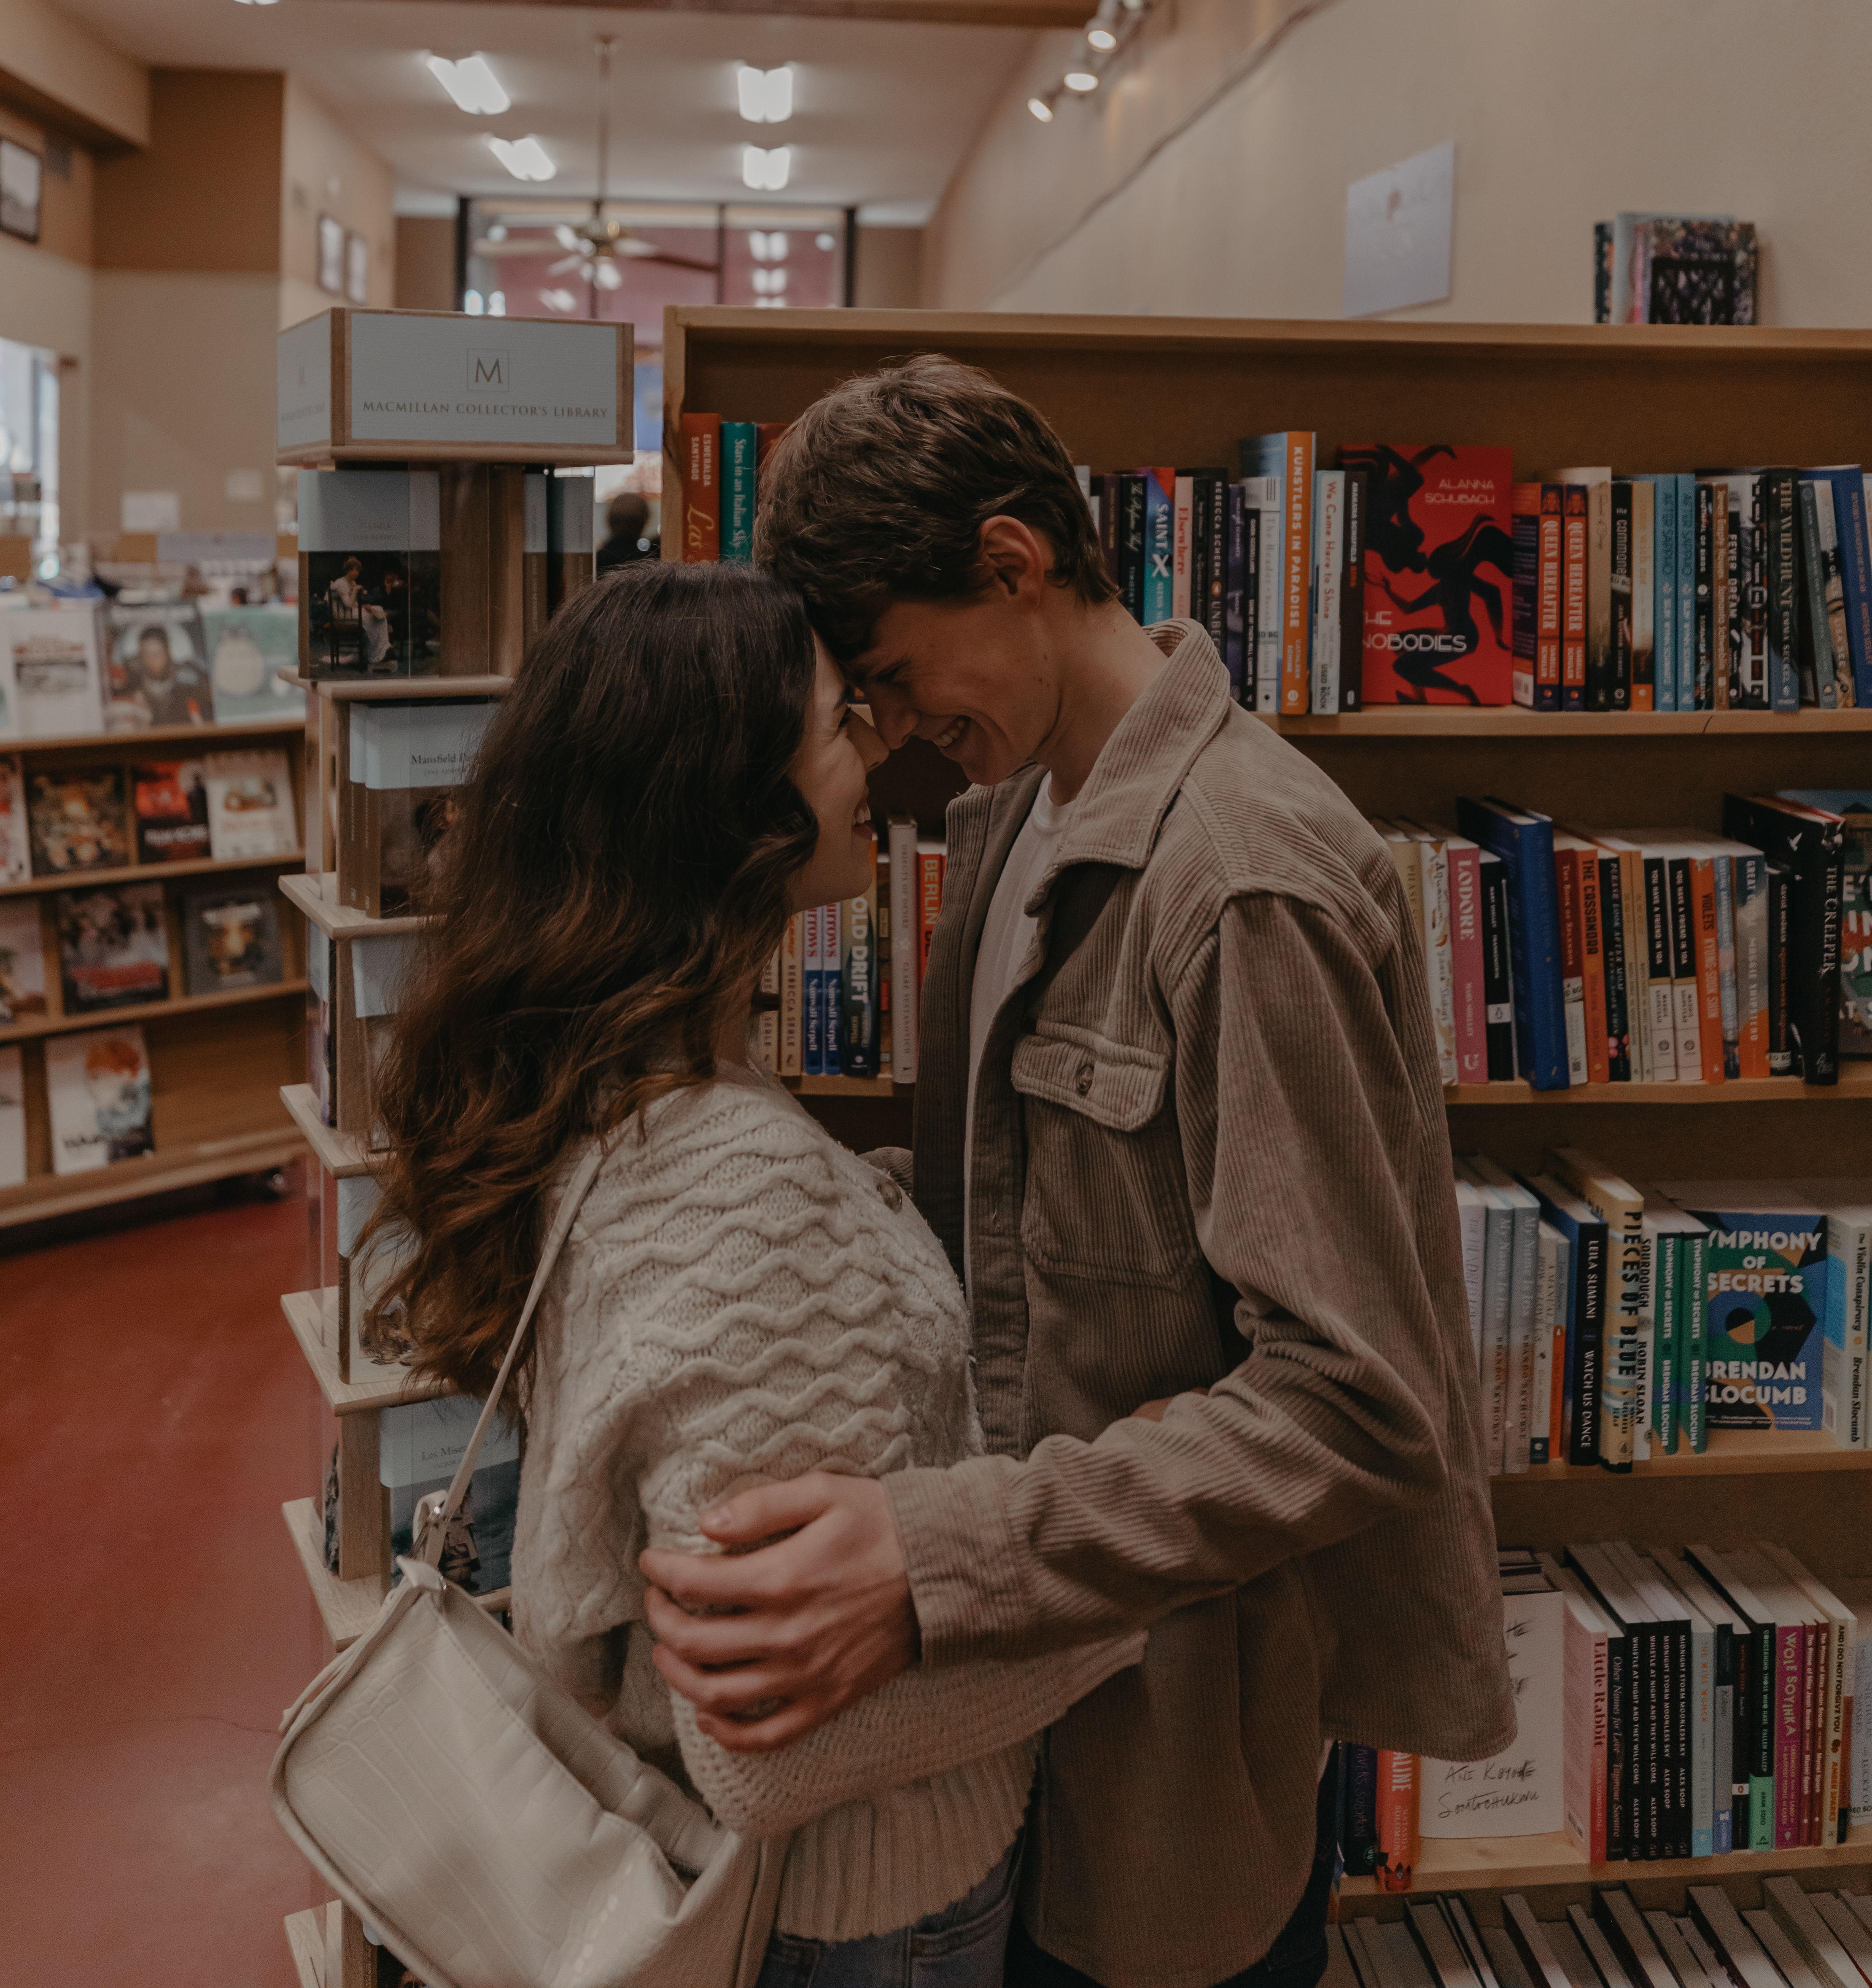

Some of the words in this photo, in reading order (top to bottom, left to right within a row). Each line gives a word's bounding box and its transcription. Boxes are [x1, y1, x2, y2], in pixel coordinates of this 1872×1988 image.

[475, 357, 502, 384] M
[363, 401, 450, 413] MACMILLAN
[456, 403, 547, 416] COLLECTOR'S
[553, 406, 607, 418] LIBRARY
[691, 436, 700, 480] SANTIAGO
[703, 433, 712, 487] ESMERALDA
[734, 438, 746, 464] Stars
[734, 465, 743, 476] in
[734, 478, 743, 492] an
[1438, 479, 1495, 490] ALANNA
[1292, 446, 1304, 530] KUNSTLERS
[1326, 481, 1337, 500] We
[1425, 492, 1495, 504] SCHUBACH
[1780, 482, 1793, 512] THE
[733, 494, 747, 527] Italian
[1214, 481, 1222, 530] REBECCA
[1325, 504, 1336, 535] Came
[687, 503, 714, 548] Las
[728, 529, 747, 548] Sky
[1156, 503, 1169, 549] SAINT
[1177, 508, 1189, 575] Elsewhere
[1543, 520, 1558, 558] QUEEN
[1568, 522, 1584, 559] QUEEN
[1780, 513, 1793, 562] WILD
[1214, 533, 1222, 576] SCHERM
[1292, 535, 1302, 550] IN
[1324, 541, 1335, 568] Here
[1729, 534, 1737, 570] FEVER
[1152, 553, 1170, 577] X
[1324, 573, 1334, 584] to
[1290, 556, 1301, 628] PARADISE
[1543, 561, 1558, 629] HEREAFTER
[1568, 563, 1583, 631] HEREAFTER
[1729, 578, 1738, 619] DREAM
[1780, 562, 1793, 608] HUNT
[1323, 588, 1334, 619] Shine
[1247, 677, 1252, 686] ME
[411, 754, 456, 764] Mansfield
[1583, 859, 1594, 881] THE
[1651, 869, 1659, 885] YOU
[1746, 860, 1755, 890] GREAT
[1826, 865, 1837, 893] THE
[924, 859, 938, 926] BERLIN
[1457, 859, 1475, 940] LODORE
[1652, 886, 1660, 905] HAVE
[851, 896, 868, 942] OLD
[1584, 886, 1598, 955] CASSANDRA
[1654, 914, 1662, 939] FRIEND
[1702, 893, 1715, 931] VIOLETS
[1656, 940, 1662, 948] IN
[1819, 898, 1839, 979] CREEPER
[850, 943, 868, 1003] DRIFT
[1704, 937, 1718, 994] KYUNG-SOOK
[787, 965, 796, 1012] REBECCA
[1707, 996, 1719, 1019] SHIN
[764, 1017, 772, 1047] SERLE
[787, 1017, 795, 1047] SERLE
[1586, 1240, 1600, 1269] LEILA
[1622, 1211, 1642, 1283] PIECES
[1707, 1230, 1822, 1251] YMPHONY
[1638, 1238, 1651, 1308] SOURDOUGH
[1743, 1255, 1766, 1270] OF
[1856, 1246, 1867, 1275] Violin
[1585, 1273, 1598, 1319] SLIMANI
[1708, 1273, 1804, 1294] SECRETS
[1622, 1291, 1639, 1316] OF
[1853, 1276, 1866, 1331] Conspiracy
[1495, 1337, 1504, 1381] BRANDO
[1619, 1326, 1637, 1376] BLUE
[1636, 1341, 1647, 1380] ROBIN
[1583, 1350, 1596, 1388] WATCH
[1662, 1359, 1672, 1402] BRENDAN
[1691, 1360, 1700, 1402] BRENDAN
[1853, 1356, 1863, 1399] Brendan
[1492, 1385, 1502, 1442] SKYHORSE
[1582, 1393, 1595, 1407] US
[1635, 1384, 1646, 1425] SLOAN
[1580, 1411, 1593, 1449] DANCE
[1661, 1404, 1670, 1447] SLOCUMB
[1689, 1404, 1698, 1447] SLOCUMB
[1851, 1400, 1862, 1443] Slocumb
[1837, 1625, 1845, 1642] AND
[1594, 1642, 1606, 1687] Little
[1782, 1632, 1798, 1671] WOLE
[1837, 1648, 1844, 1659] DO
[1613, 1656, 1622, 1681] Other
[1633, 1671, 1640, 1679] AT
[1650, 1669, 1657, 1678] AT
[1836, 1661, 1844, 1677] NOT
[1613, 1685, 1622, 1714] Names
[1782, 1676, 1798, 1736] SOYINKA
[1834, 1680, 1843, 1714] FORGIVE
[1594, 1691, 1606, 1747] Rabbit
[1612, 1717, 1622, 1729] for
[1834, 1716, 1842, 1733] YOU
[1613, 1732, 1622, 1753] Love
[1830, 1761, 1839, 1789] AMBER
[1829, 1791, 1838, 1821] SPARKS
